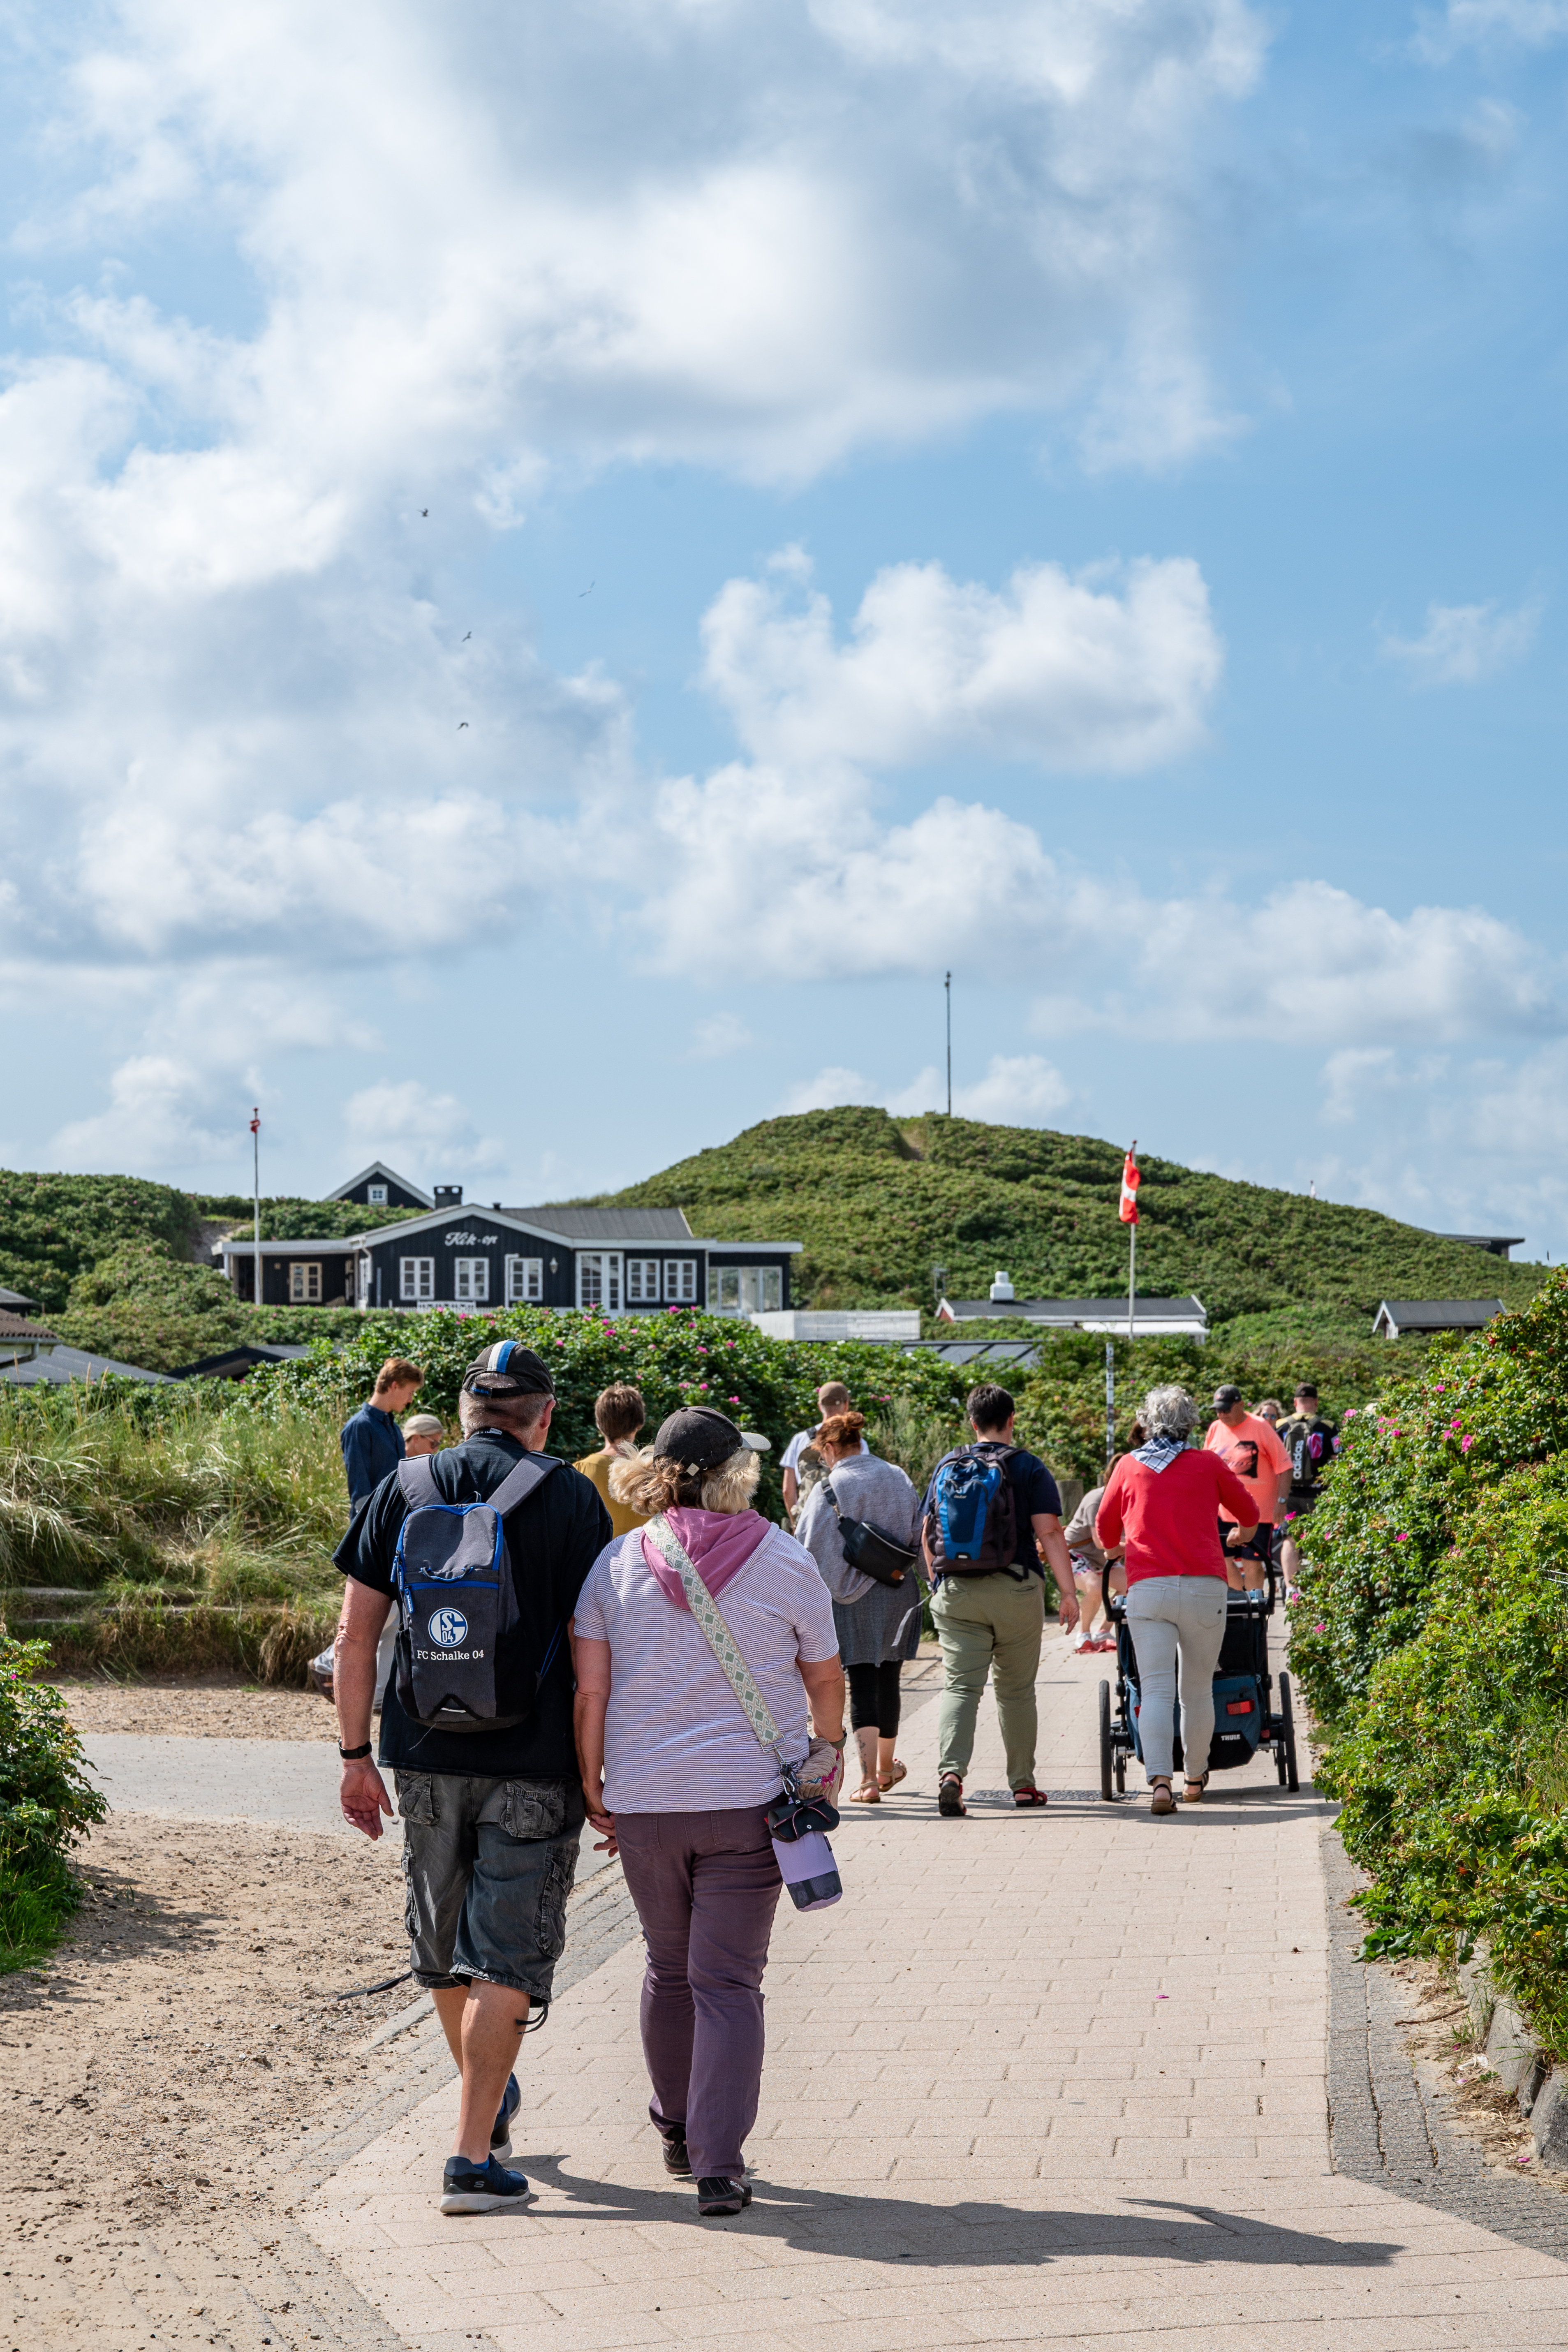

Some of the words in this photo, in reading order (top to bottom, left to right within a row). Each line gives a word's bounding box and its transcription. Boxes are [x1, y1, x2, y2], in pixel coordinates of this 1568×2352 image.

[1293, 1440, 1304, 1480] adidas
[442, 1631, 453, 1642] 04
[417, 1650, 428, 1660] FC
[430, 1651, 469, 1661] Schalke
[472, 1650, 484, 1659] 04
